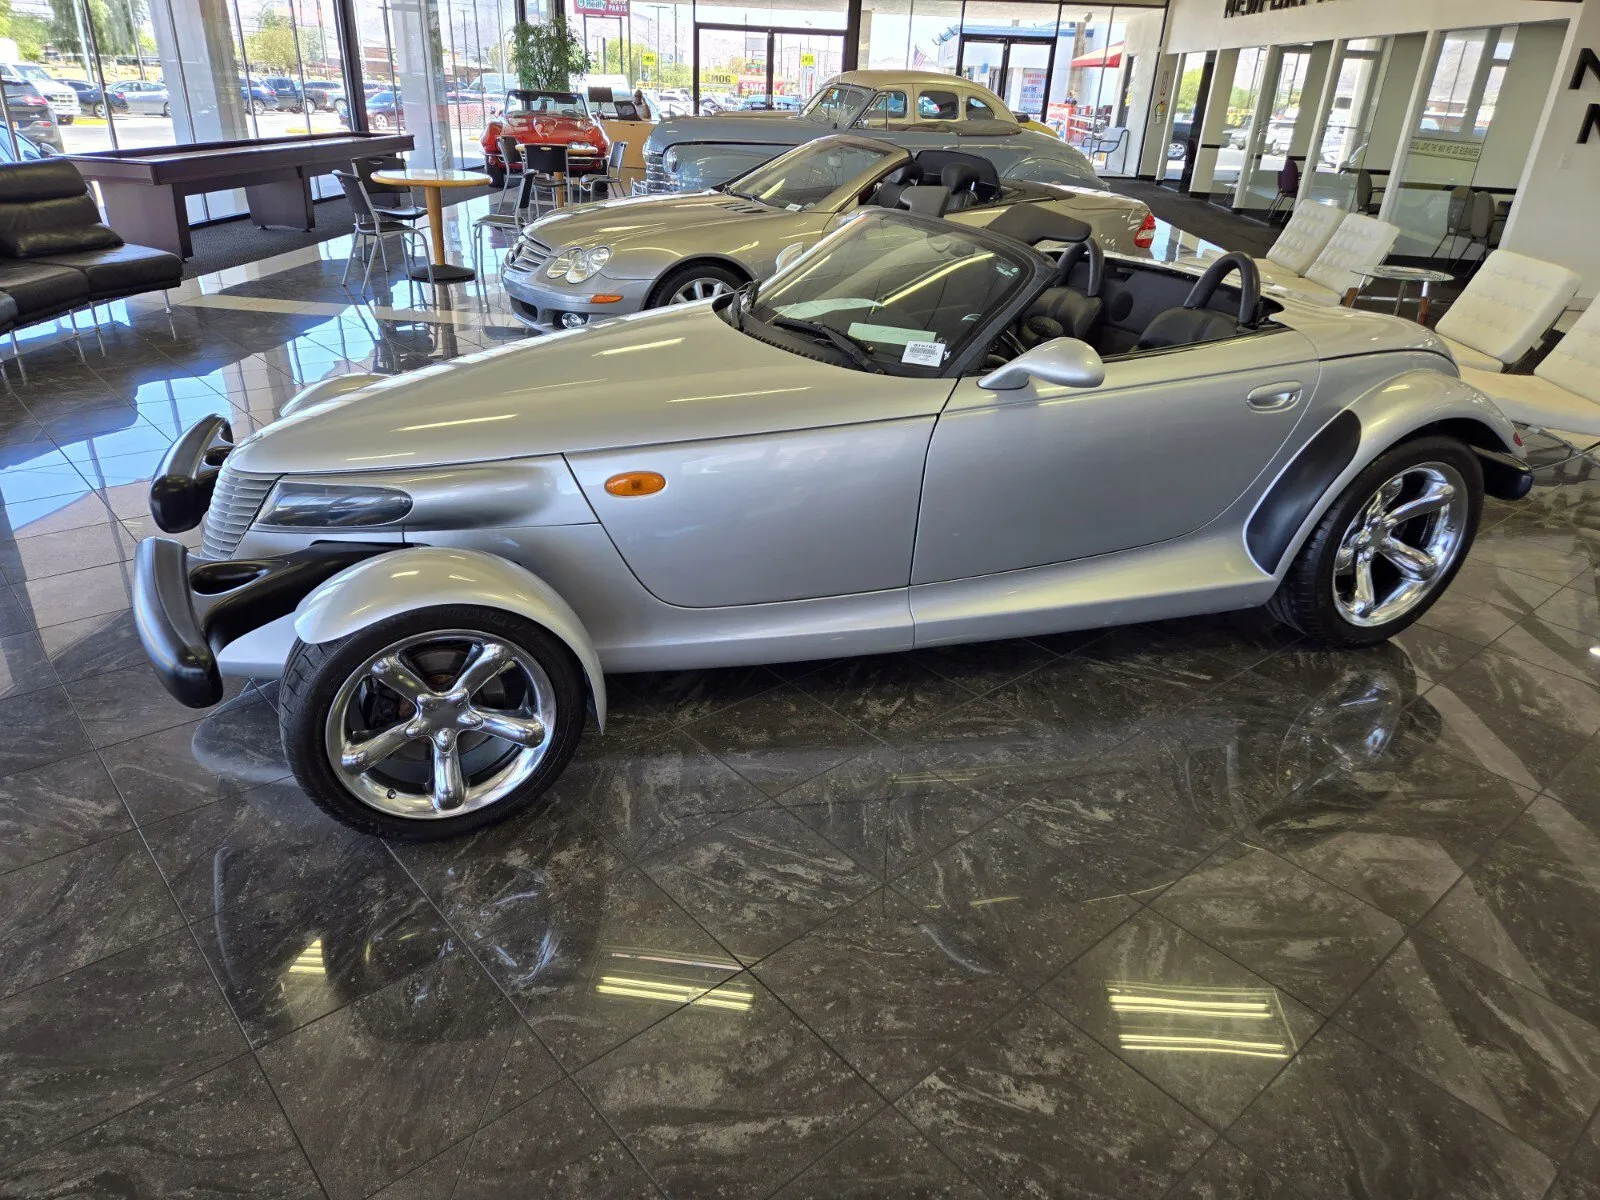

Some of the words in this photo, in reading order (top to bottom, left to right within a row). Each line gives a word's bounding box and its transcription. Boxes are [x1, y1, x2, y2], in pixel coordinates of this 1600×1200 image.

[578, 0, 607, 10] OReilly
[608, 4, 627, 12] PARTS
[1223, 0, 1306, 18] NEWPO
[704, 74, 731, 83] SMOG
[741, 82, 766, 90] SMO
